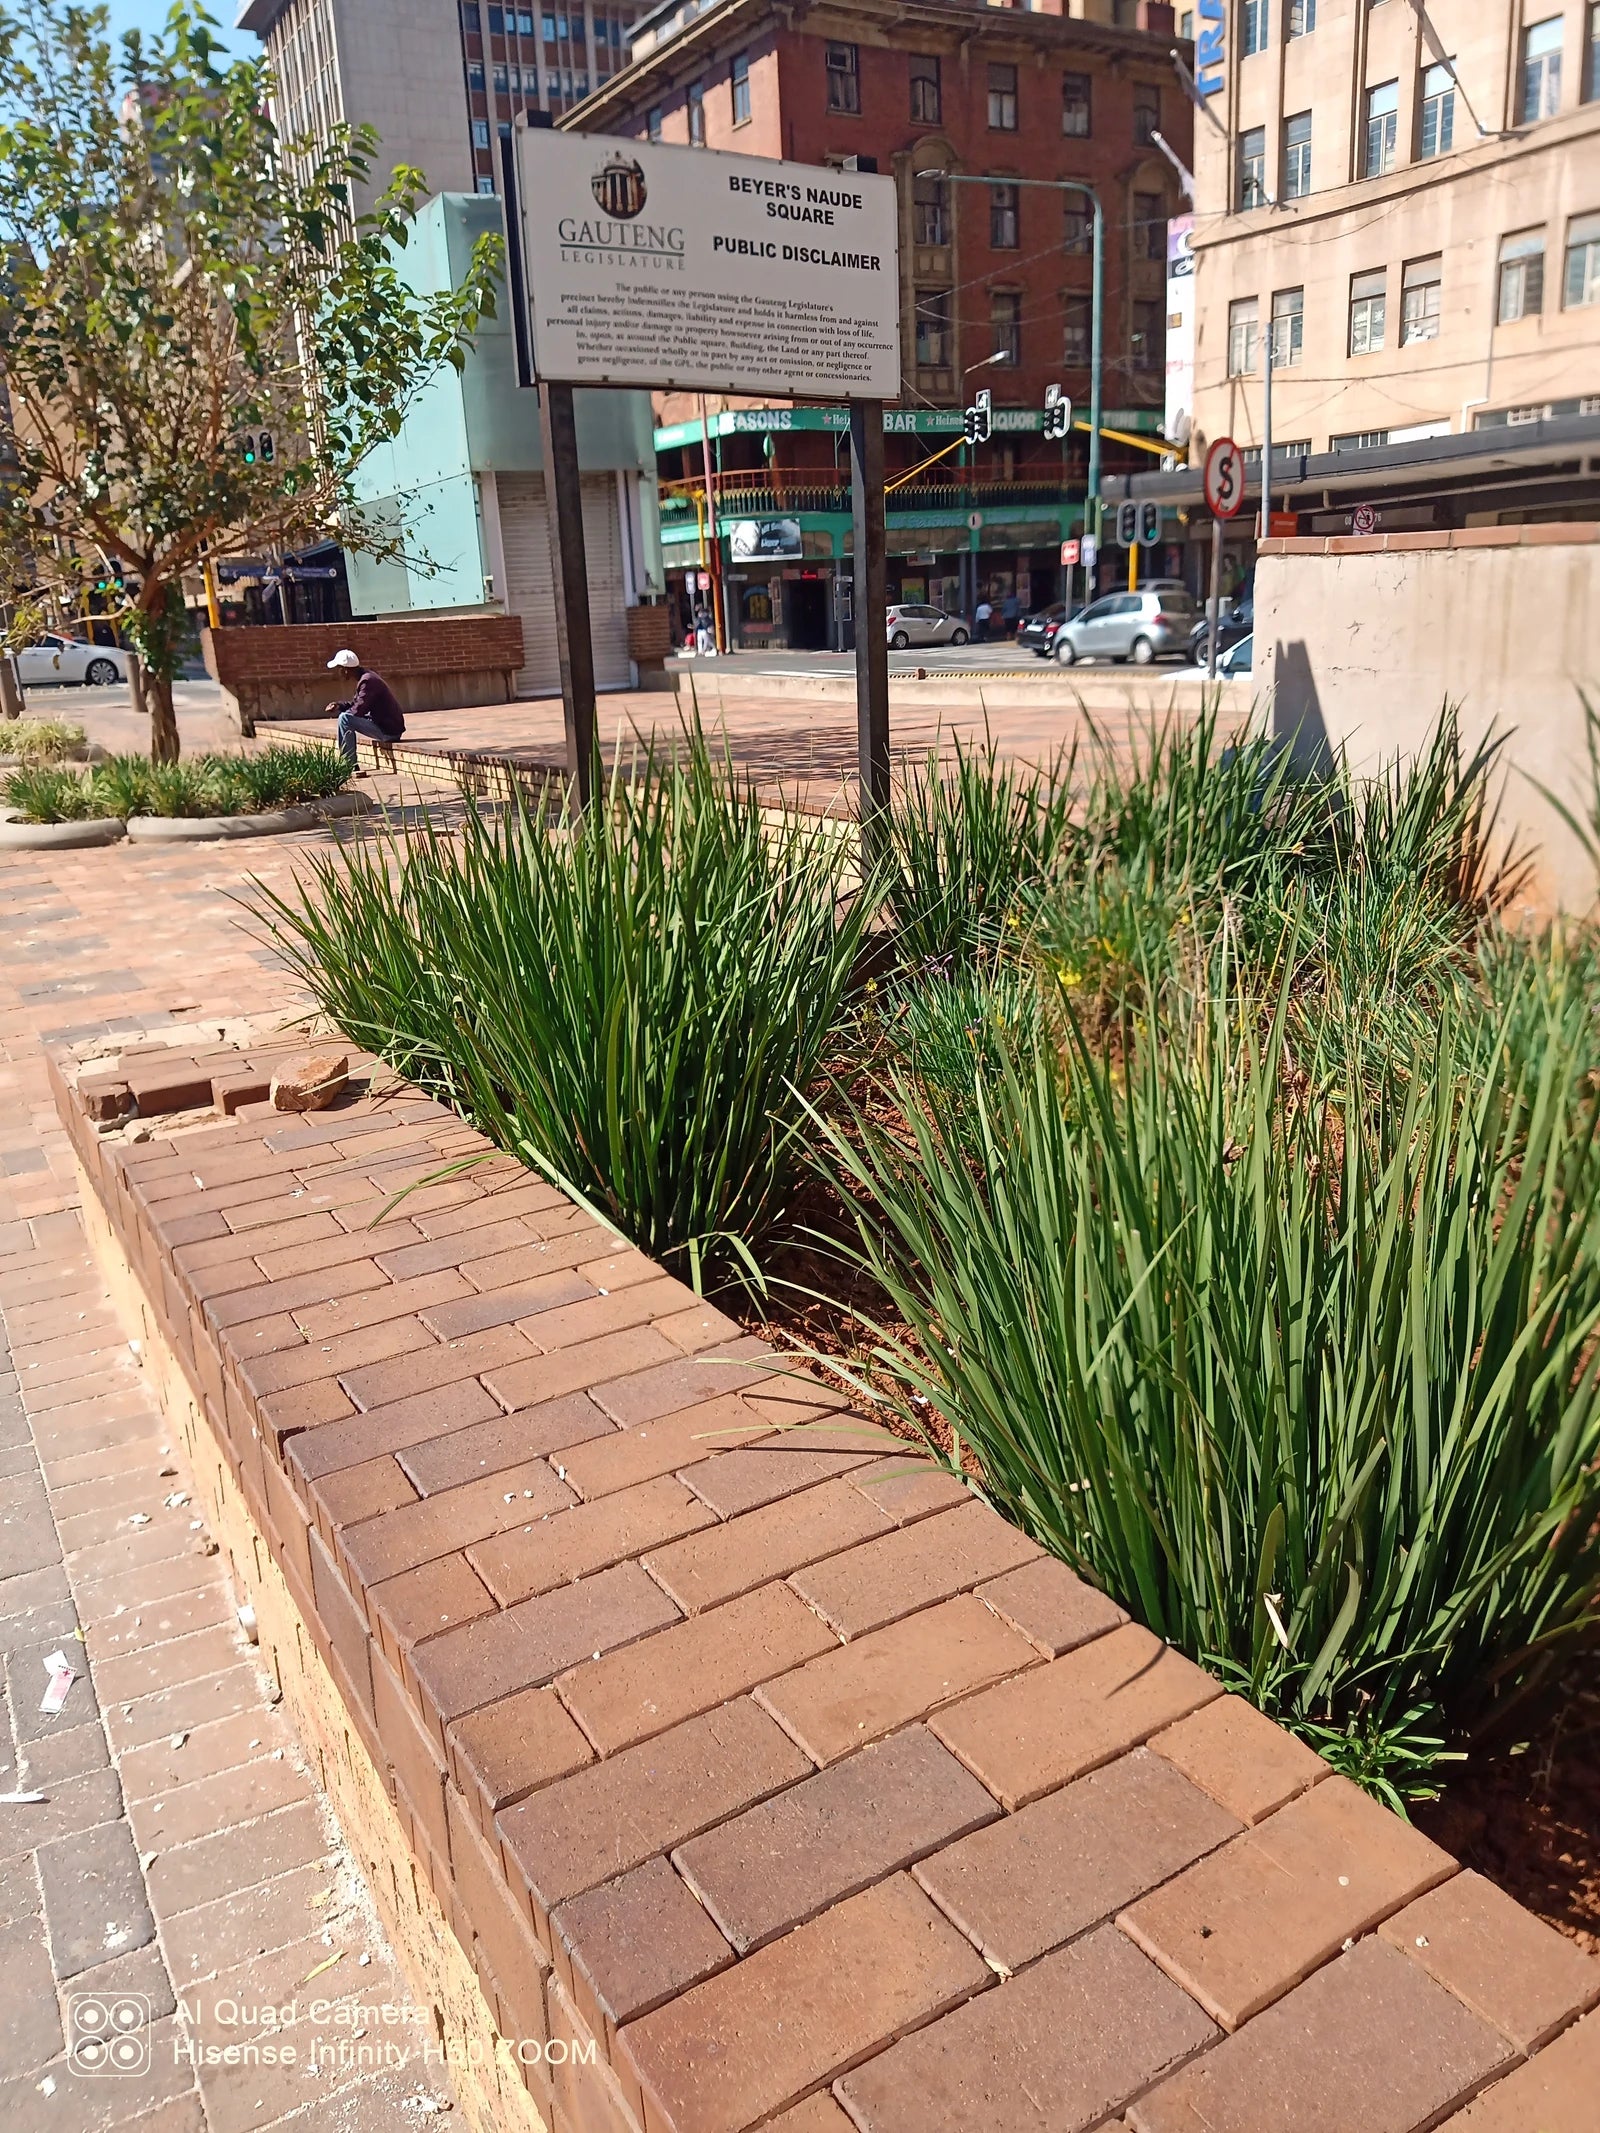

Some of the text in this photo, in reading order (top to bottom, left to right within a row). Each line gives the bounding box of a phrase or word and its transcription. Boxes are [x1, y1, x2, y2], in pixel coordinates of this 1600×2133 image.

[729, 176, 863, 209] BEYER'S NAUDE
[766, 202, 835, 225] SQUARE
[558, 218, 685, 251] GAUTENG
[561, 250, 685, 270] LEGISLATURE
[712, 235, 881, 271] PUBLIC DISCLAIMER
[561, 293, 595, 304] precinct
[597, 295, 626, 306] hereby
[678, 299, 691, 308] the
[693, 301, 736, 313] Legislature
[738, 308, 752, 316] and
[754, 308, 775, 318] holds
[777, 311, 783, 319] it
[785, 311, 818, 322] harmless
[820, 314, 837, 324] from
[839, 317, 852, 325] and
[854, 319, 879, 328] against
[616, 283, 631, 292] The
[633, 286, 659, 295] public
[672, 290, 687, 298] any
[688, 291, 716, 300] person
[718, 294, 739, 304] using
[740, 295, 753, 303] the
[755, 296, 787, 309] Gauteng
[789, 300, 834, 312] Legislature's
[546, 318, 583, 327] personal
[685, 326, 719, 337] property
[720, 328, 761, 339] howsoever
[763, 333, 790, 345] arising
[791, 335, 809, 343] from
[834, 339, 842, 347] of
[843, 341, 857, 350] any
[857, 342, 894, 350] occurrence
[567, 305, 579, 314] all
[686, 313, 717, 325] liability
[718, 317, 733, 325] and
[735, 319, 765, 330] expense
[767, 321, 775, 329] in
[777, 324, 817, 334] connection
[819, 327, 835, 335] with
[837, 327, 851, 336] loss
[852, 329, 861, 337] of
[861, 330, 875, 339] life,
[576, 342, 614, 351] Whether
[661, 347, 689, 357] wholly
[711, 352, 728, 361] part
[728, 352, 739, 362] by
[741, 354, 755, 364] any
[779, 357, 815, 367] omission,
[826, 361, 864, 372] negligence
[673, 335, 698, 345] Public
[767, 343, 779, 352] the
[781, 345, 800, 354] Land
[811, 350, 824, 358] any
[826, 350, 841, 359] part
[710, 361, 734, 372] public
[747, 366, 761, 376] any
[762, 366, 782, 375] other
[783, 369, 804, 379] agent
[815, 371, 873, 382] concessionaries.
[883, 413, 917, 431] BAR
[1216, 456, 1234, 500] S
